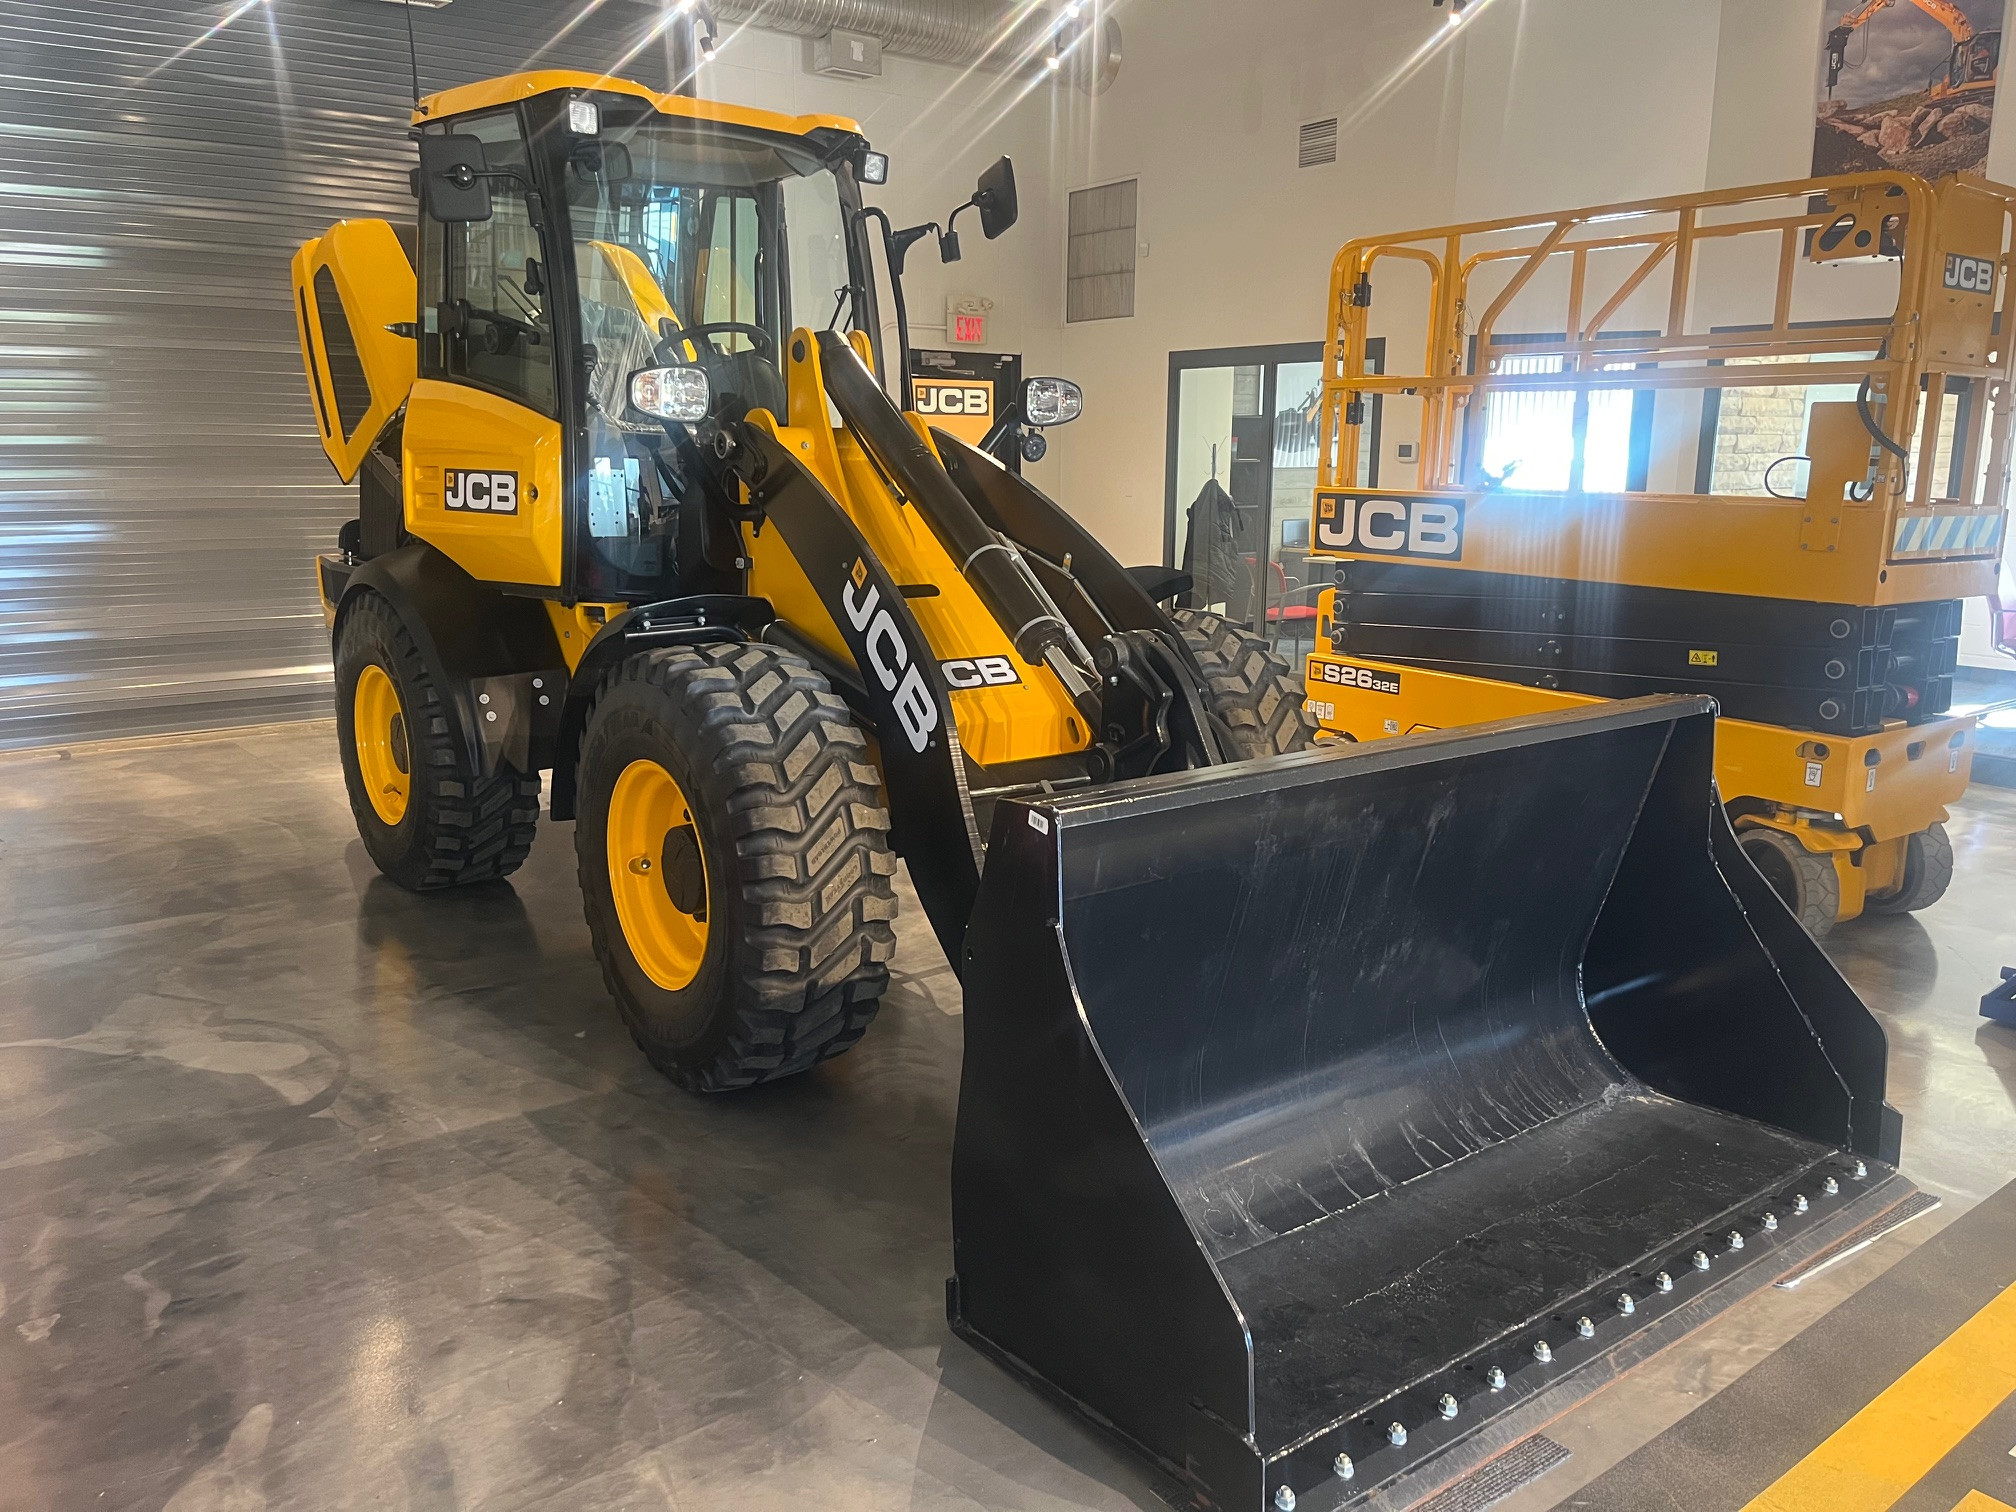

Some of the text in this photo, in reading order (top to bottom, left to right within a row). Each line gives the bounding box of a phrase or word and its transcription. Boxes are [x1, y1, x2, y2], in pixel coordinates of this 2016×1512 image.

[1831, 53, 1839, 69] JCB
[1945, 257, 1993, 291] JCB
[956, 316, 983, 342] EXIT
[917, 388, 988, 414] JCB
[446, 473, 516, 511] JCB
[1319, 499, 1459, 554] JCB
[842, 579, 938, 753] JCB
[942, 657, 1018, 688] CB
[811, 829, 841, 865] POWERLOAD
